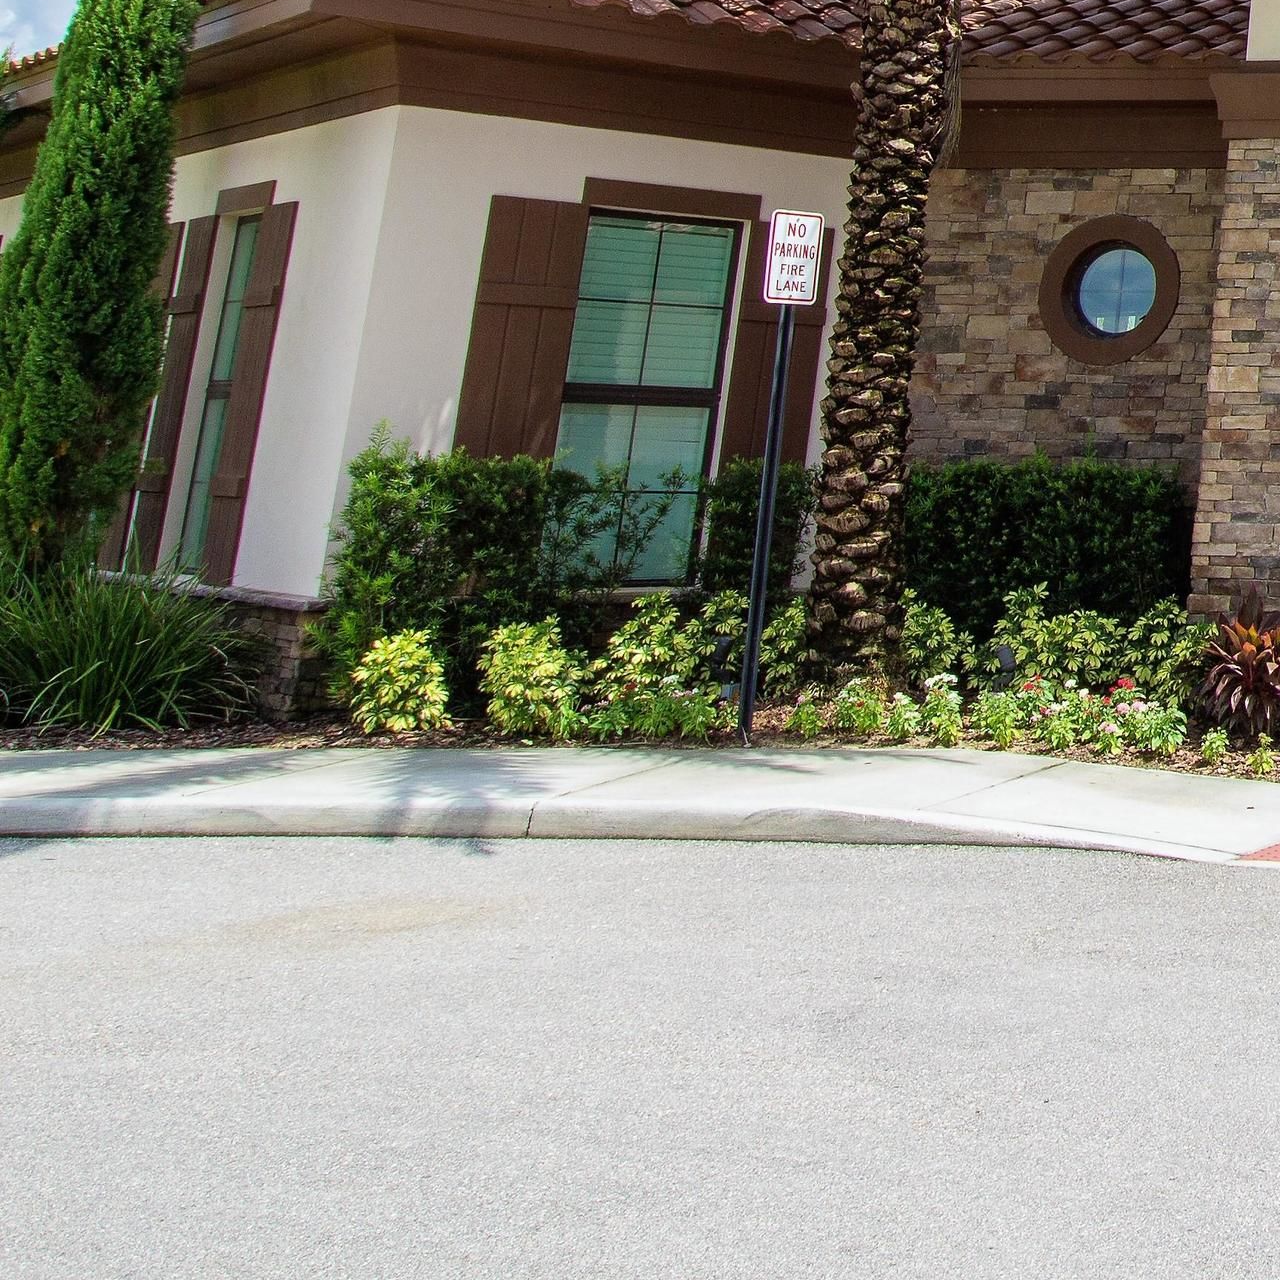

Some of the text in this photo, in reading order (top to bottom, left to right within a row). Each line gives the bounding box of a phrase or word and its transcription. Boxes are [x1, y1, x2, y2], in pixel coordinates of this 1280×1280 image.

[787, 222, 807, 238] NO
[774, 242, 817, 260] PARKING
[780, 263, 806, 276] FIRE
[775, 279, 807, 293] LANE
